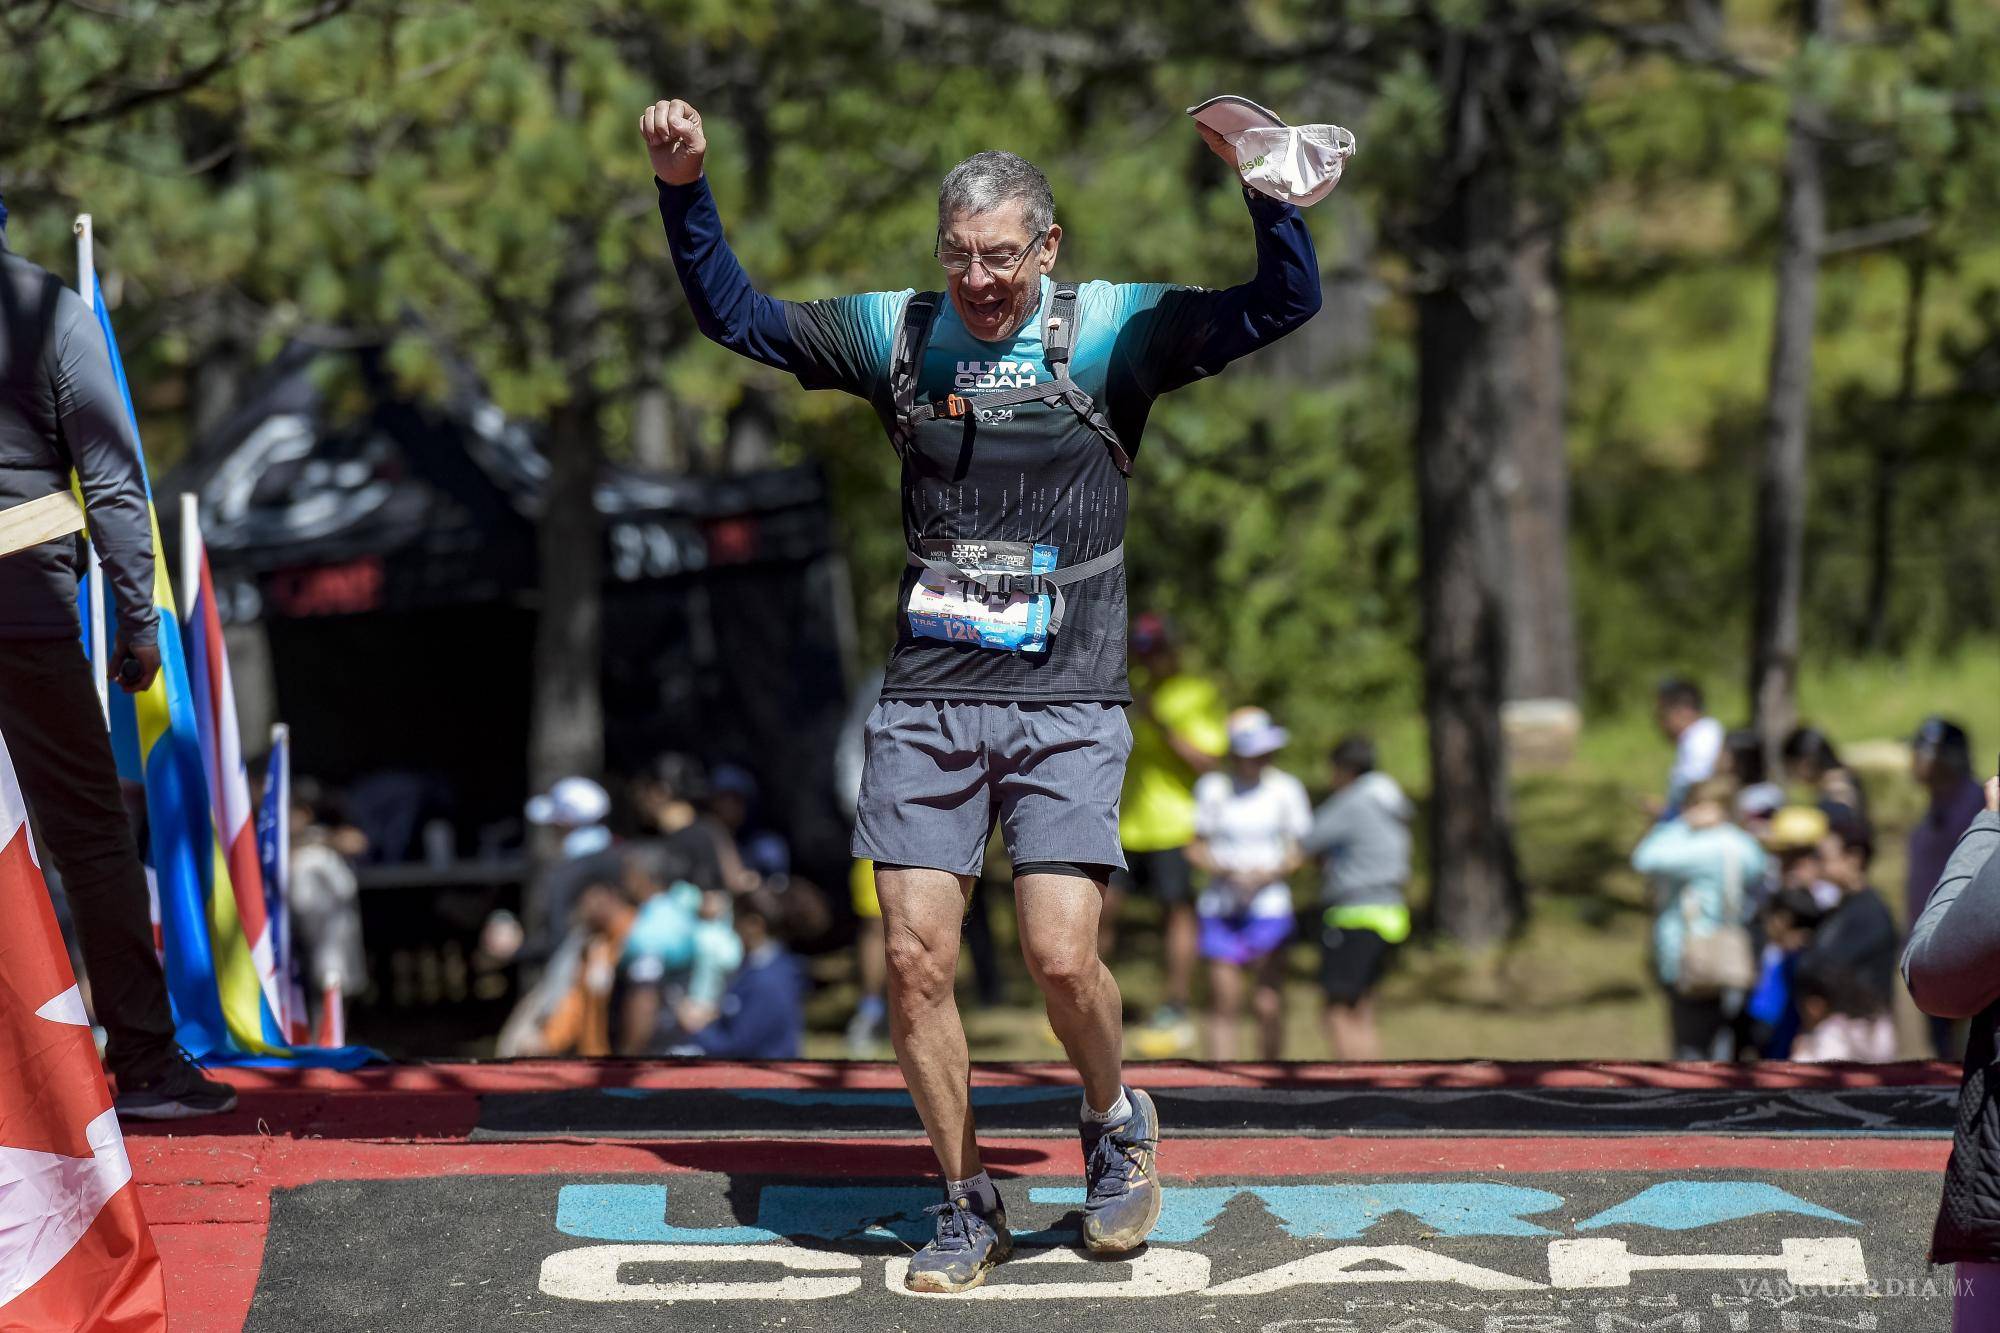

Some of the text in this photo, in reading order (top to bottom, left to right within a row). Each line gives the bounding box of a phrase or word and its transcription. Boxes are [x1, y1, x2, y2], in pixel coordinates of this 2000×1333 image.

[956, 361, 1036, 375] ULTRA
[954, 373, 1037, 389] COAH
[951, 551, 988, 559] COAH
[538, 1236, 1869, 1301] COAH
